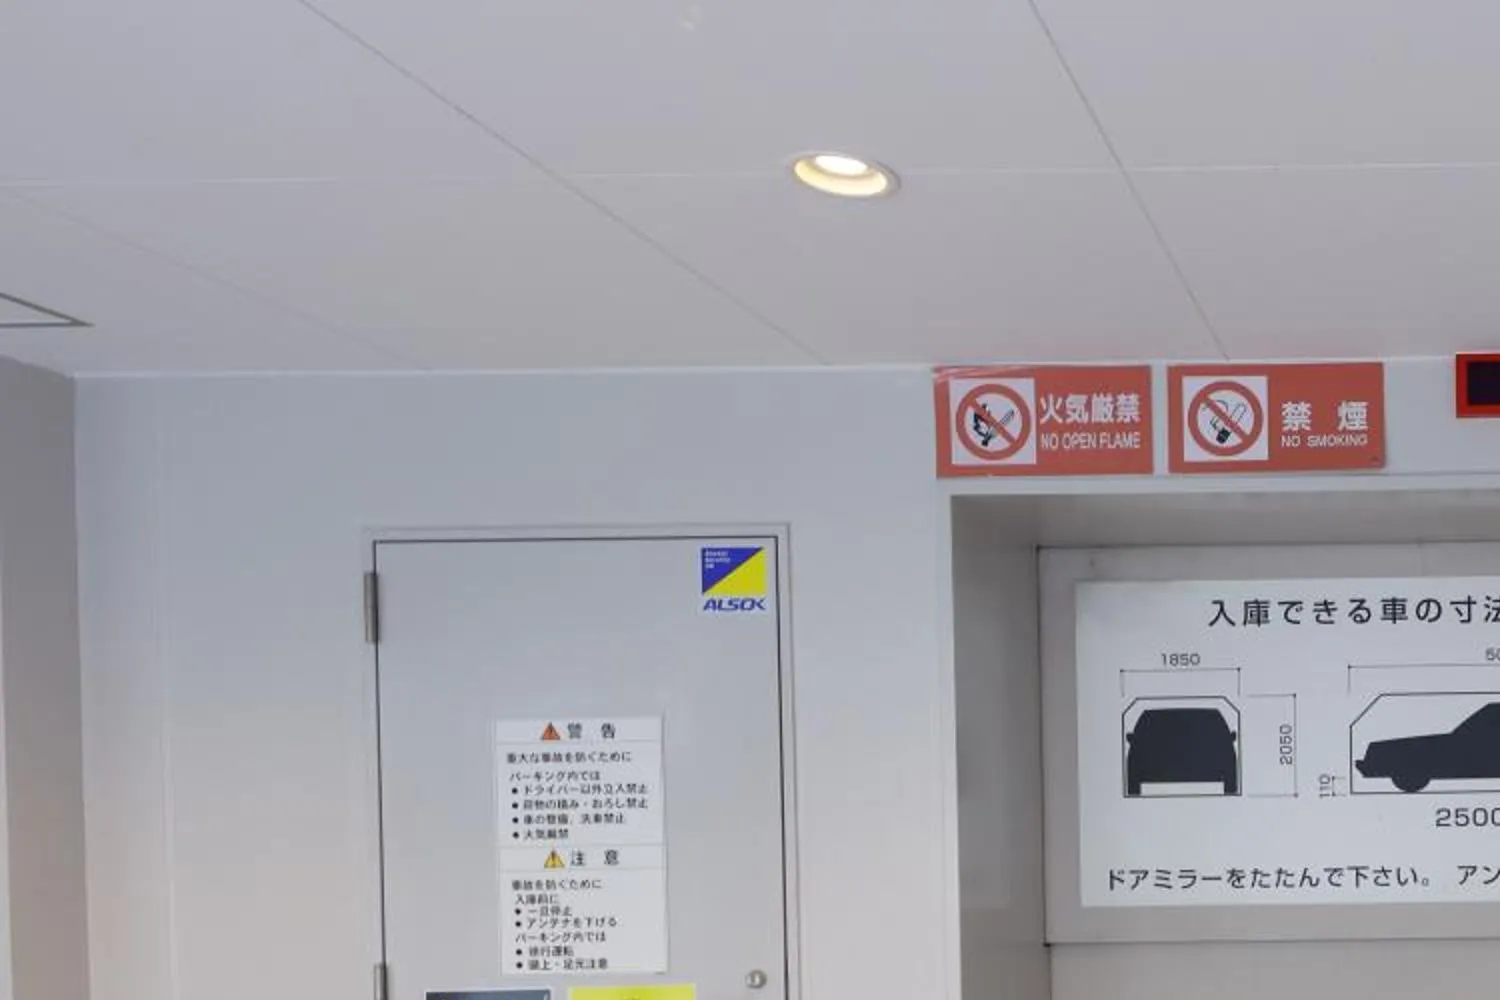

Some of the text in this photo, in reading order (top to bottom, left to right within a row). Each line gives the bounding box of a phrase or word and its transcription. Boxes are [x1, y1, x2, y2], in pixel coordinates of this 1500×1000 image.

[1039, 393, 1141, 424] 火気厳禁
[1041, 432, 1141, 449] NO OPEN FLAME
[1281, 433, 1368, 447] NO SMOKING
[703, 598, 766, 612] ALSOK
[1161, 653, 1200, 667] 1850
[1279, 724, 1293, 765] 2050
[1319, 774, 1331, 798] 110
[1108, 867, 1432, 890] ドアミラーをたたんで下さい。
